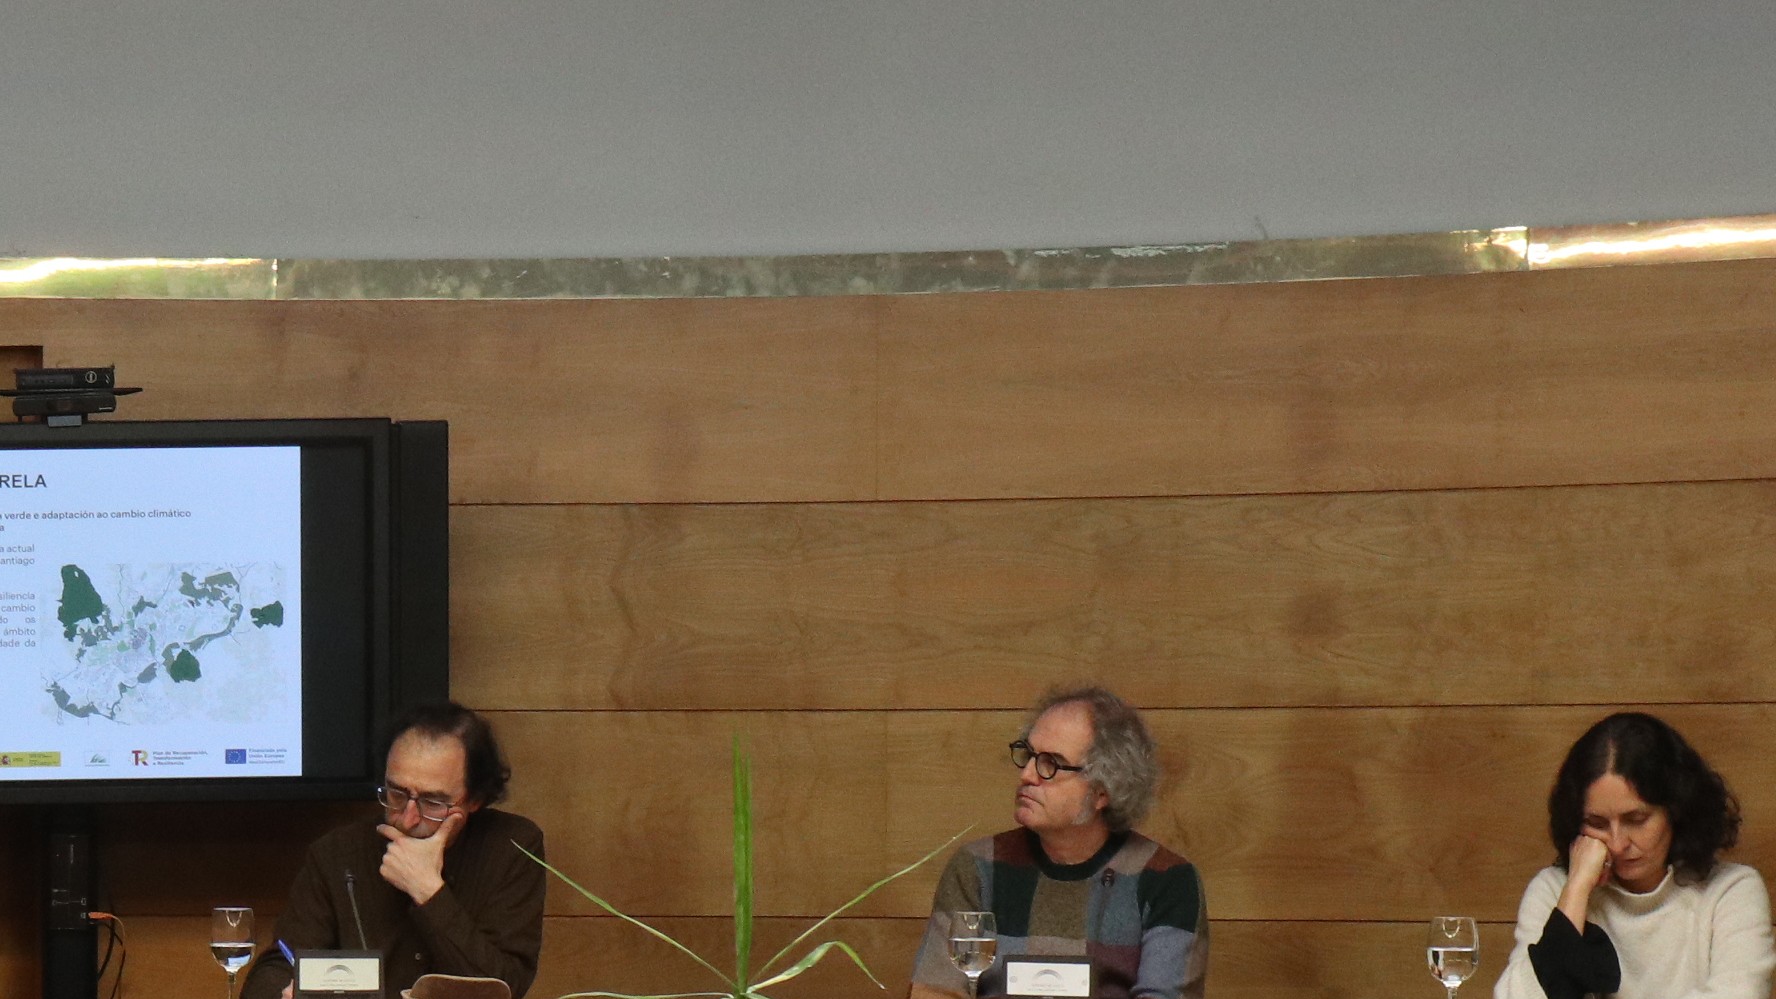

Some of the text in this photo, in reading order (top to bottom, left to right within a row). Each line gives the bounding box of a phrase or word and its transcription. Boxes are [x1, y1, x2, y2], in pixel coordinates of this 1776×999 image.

[41, 509, 94, 521] adaptación
[96, 511, 108, 519] ao
[111, 509, 145, 519] cambio
[148, 509, 191, 518] climático
[7, 544, 34, 553] actual
[1, 604, 35, 612] cambio
[4, 627, 36, 636] ámbito
